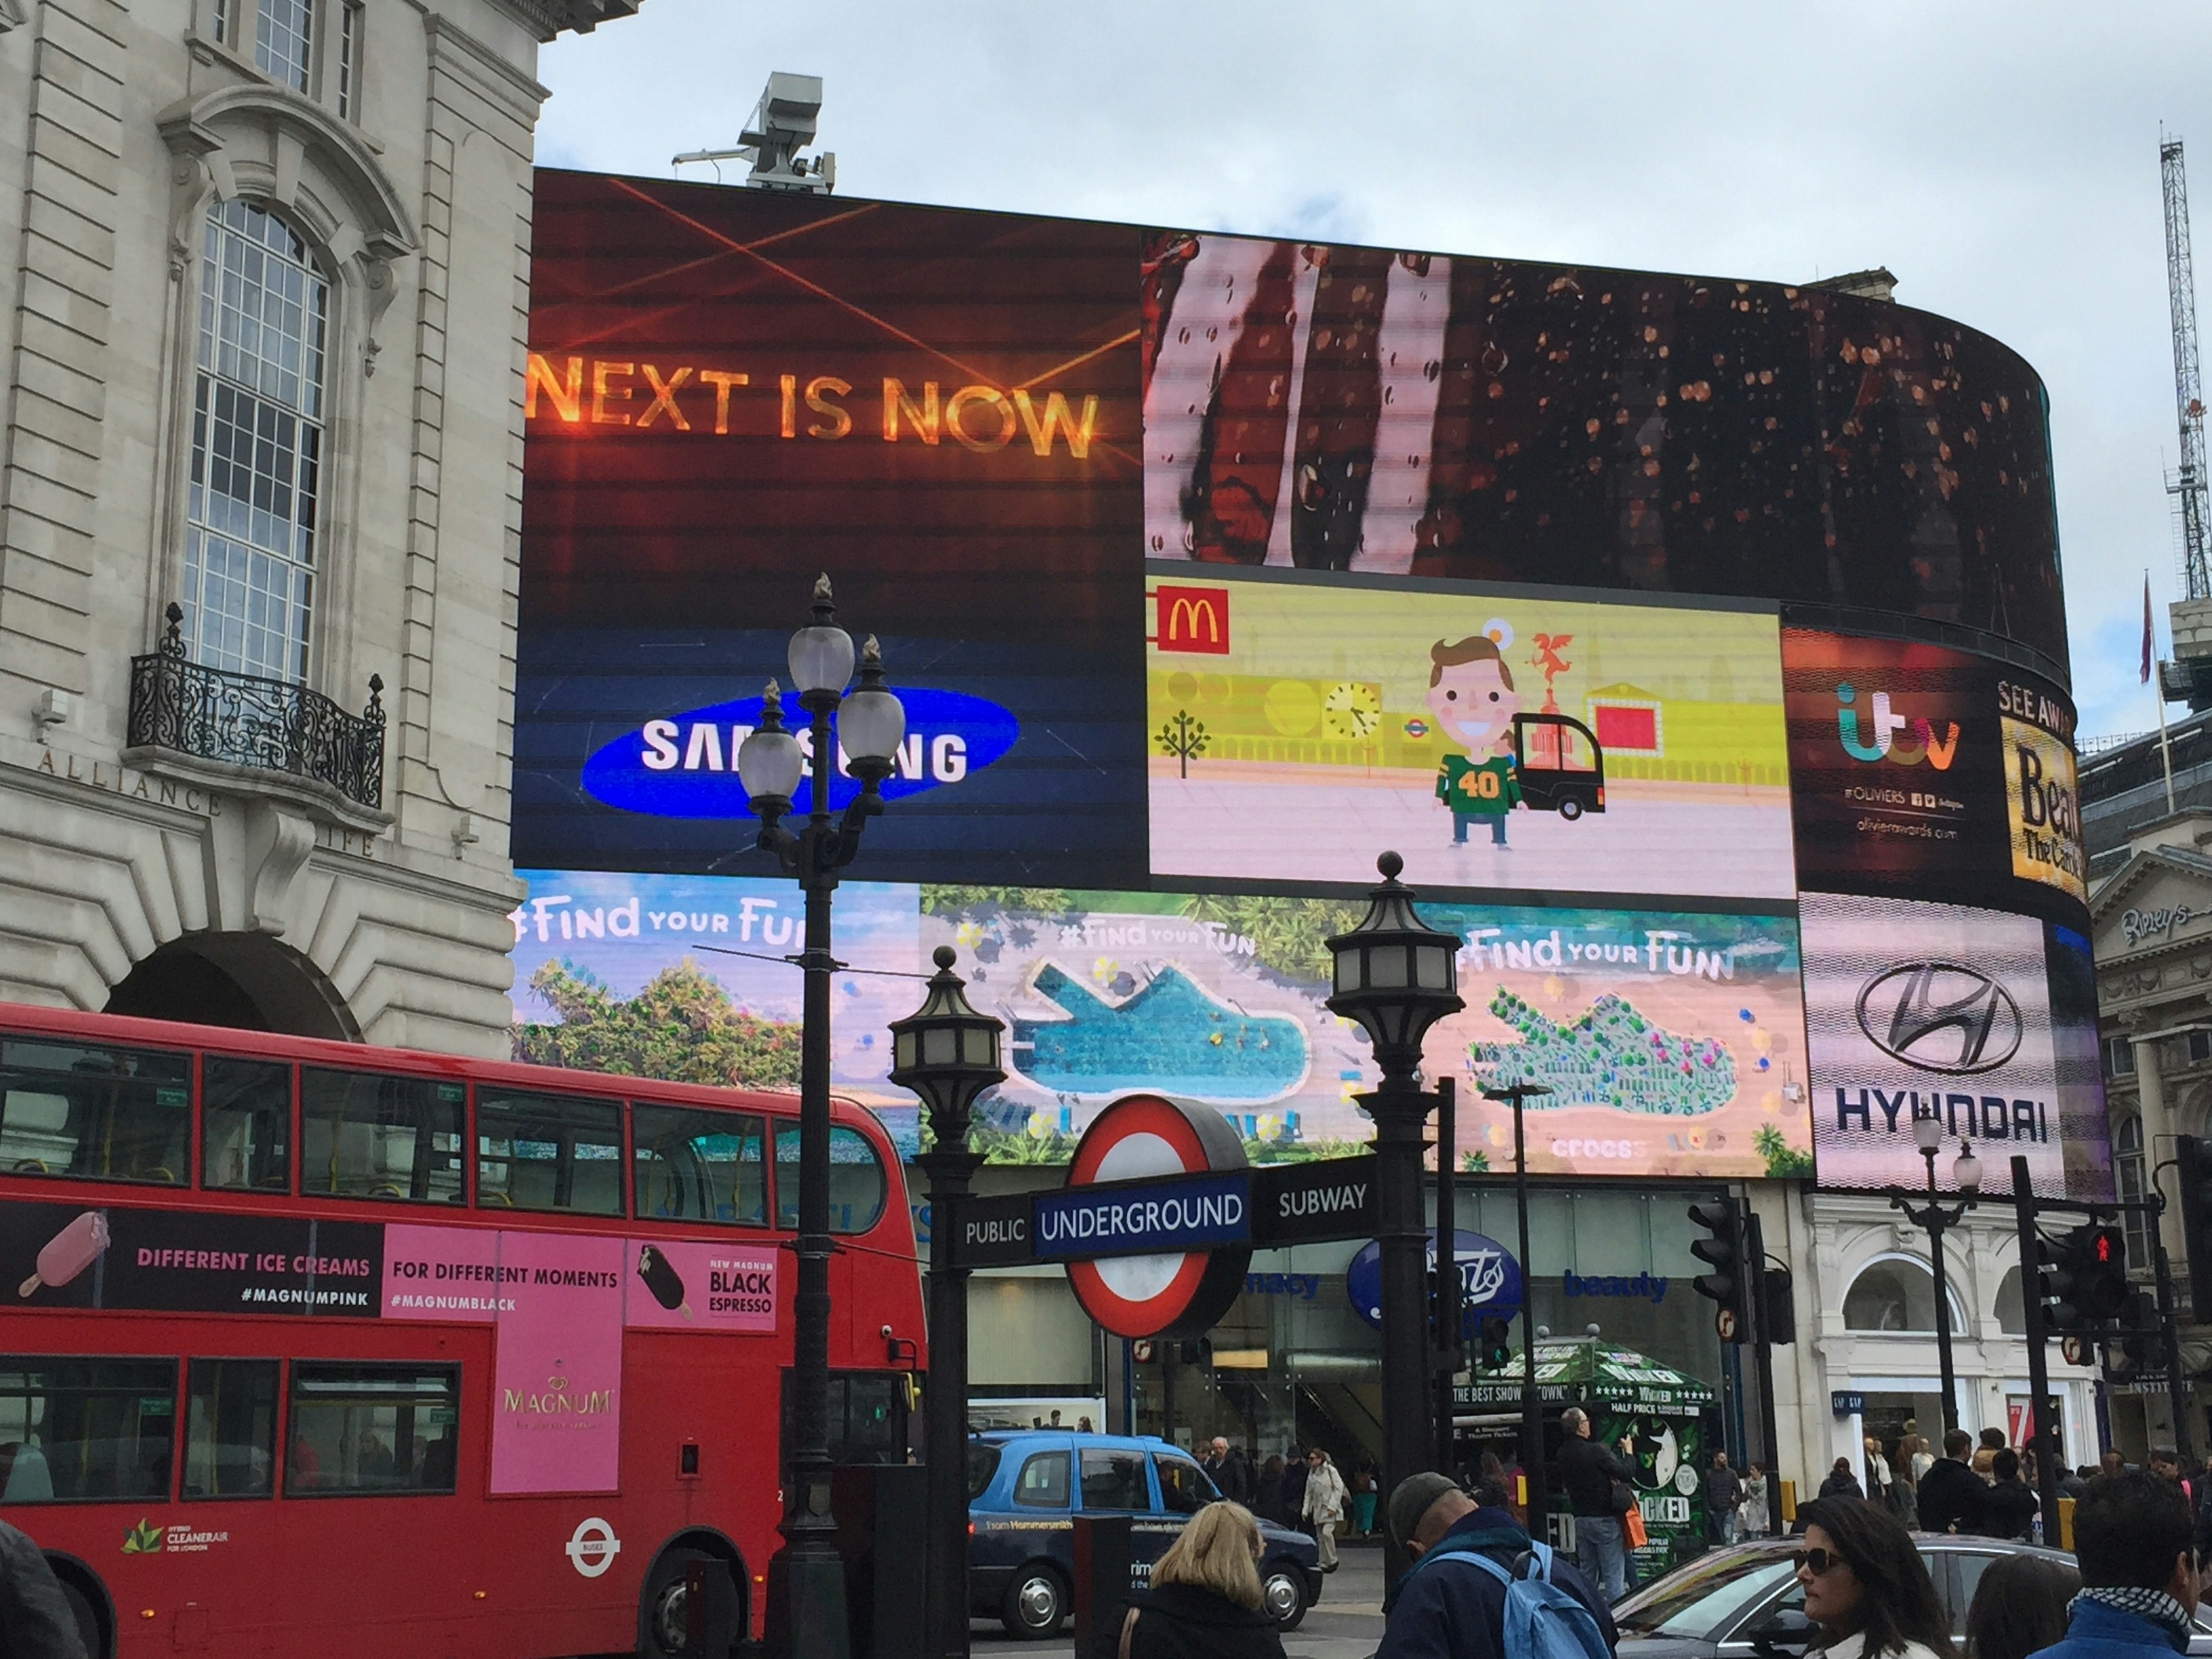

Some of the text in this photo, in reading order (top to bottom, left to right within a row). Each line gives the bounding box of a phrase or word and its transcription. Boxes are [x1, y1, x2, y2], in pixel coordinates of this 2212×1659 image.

[526, 353, 1098, 459] NEXT IS NOW
[1999, 680, 2035, 719] SEE
[1837, 682, 1959, 770] itv
[642, 720, 966, 783] SASNG
[37, 749, 222, 817] ALLIANCE
[1458, 770, 1500, 798] 40
[314, 827, 374, 857] IFE
[648, 911, 729, 933] YOUR
[1152, 929, 1199, 944] YOUR
[1205, 921, 1256, 956] FUN
[1568, 942, 1638, 964] YOUR
[1836, 1088, 2047, 1143] HYUNDAI
[1551, 1139, 1634, 1159] crocs
[1279, 1183, 1368, 1218] SUBWAY
[1041, 1193, 1243, 1241] UNDERGROUND
[966, 1218, 1025, 1245] PUBLIC
[138, 1248, 371, 1277] DIFFERENT ICE CREAMS
[393, 1261, 617, 1288] FOR DIFFERENT MOMENTS
[710, 1271, 771, 1294] BLACK
[1564, 1269, 1667, 1303] beauty
[241, 1288, 369, 1306] #MAGNUMPINK
[391, 1294, 516, 1311] #MAGNUMBLACK
[710, 1297, 772, 1313] ESPRESSO
[504, 1389, 610, 1415] MAGNUM
[1453, 1387, 1469, 1402] THE
[1471, 1387, 1494, 1402] BEST
[1496, 1386, 1521, 1401] SHOW
[1612, 1403, 1632, 1412] HALF
[1634, 1404, 1656, 1414] PRICE
